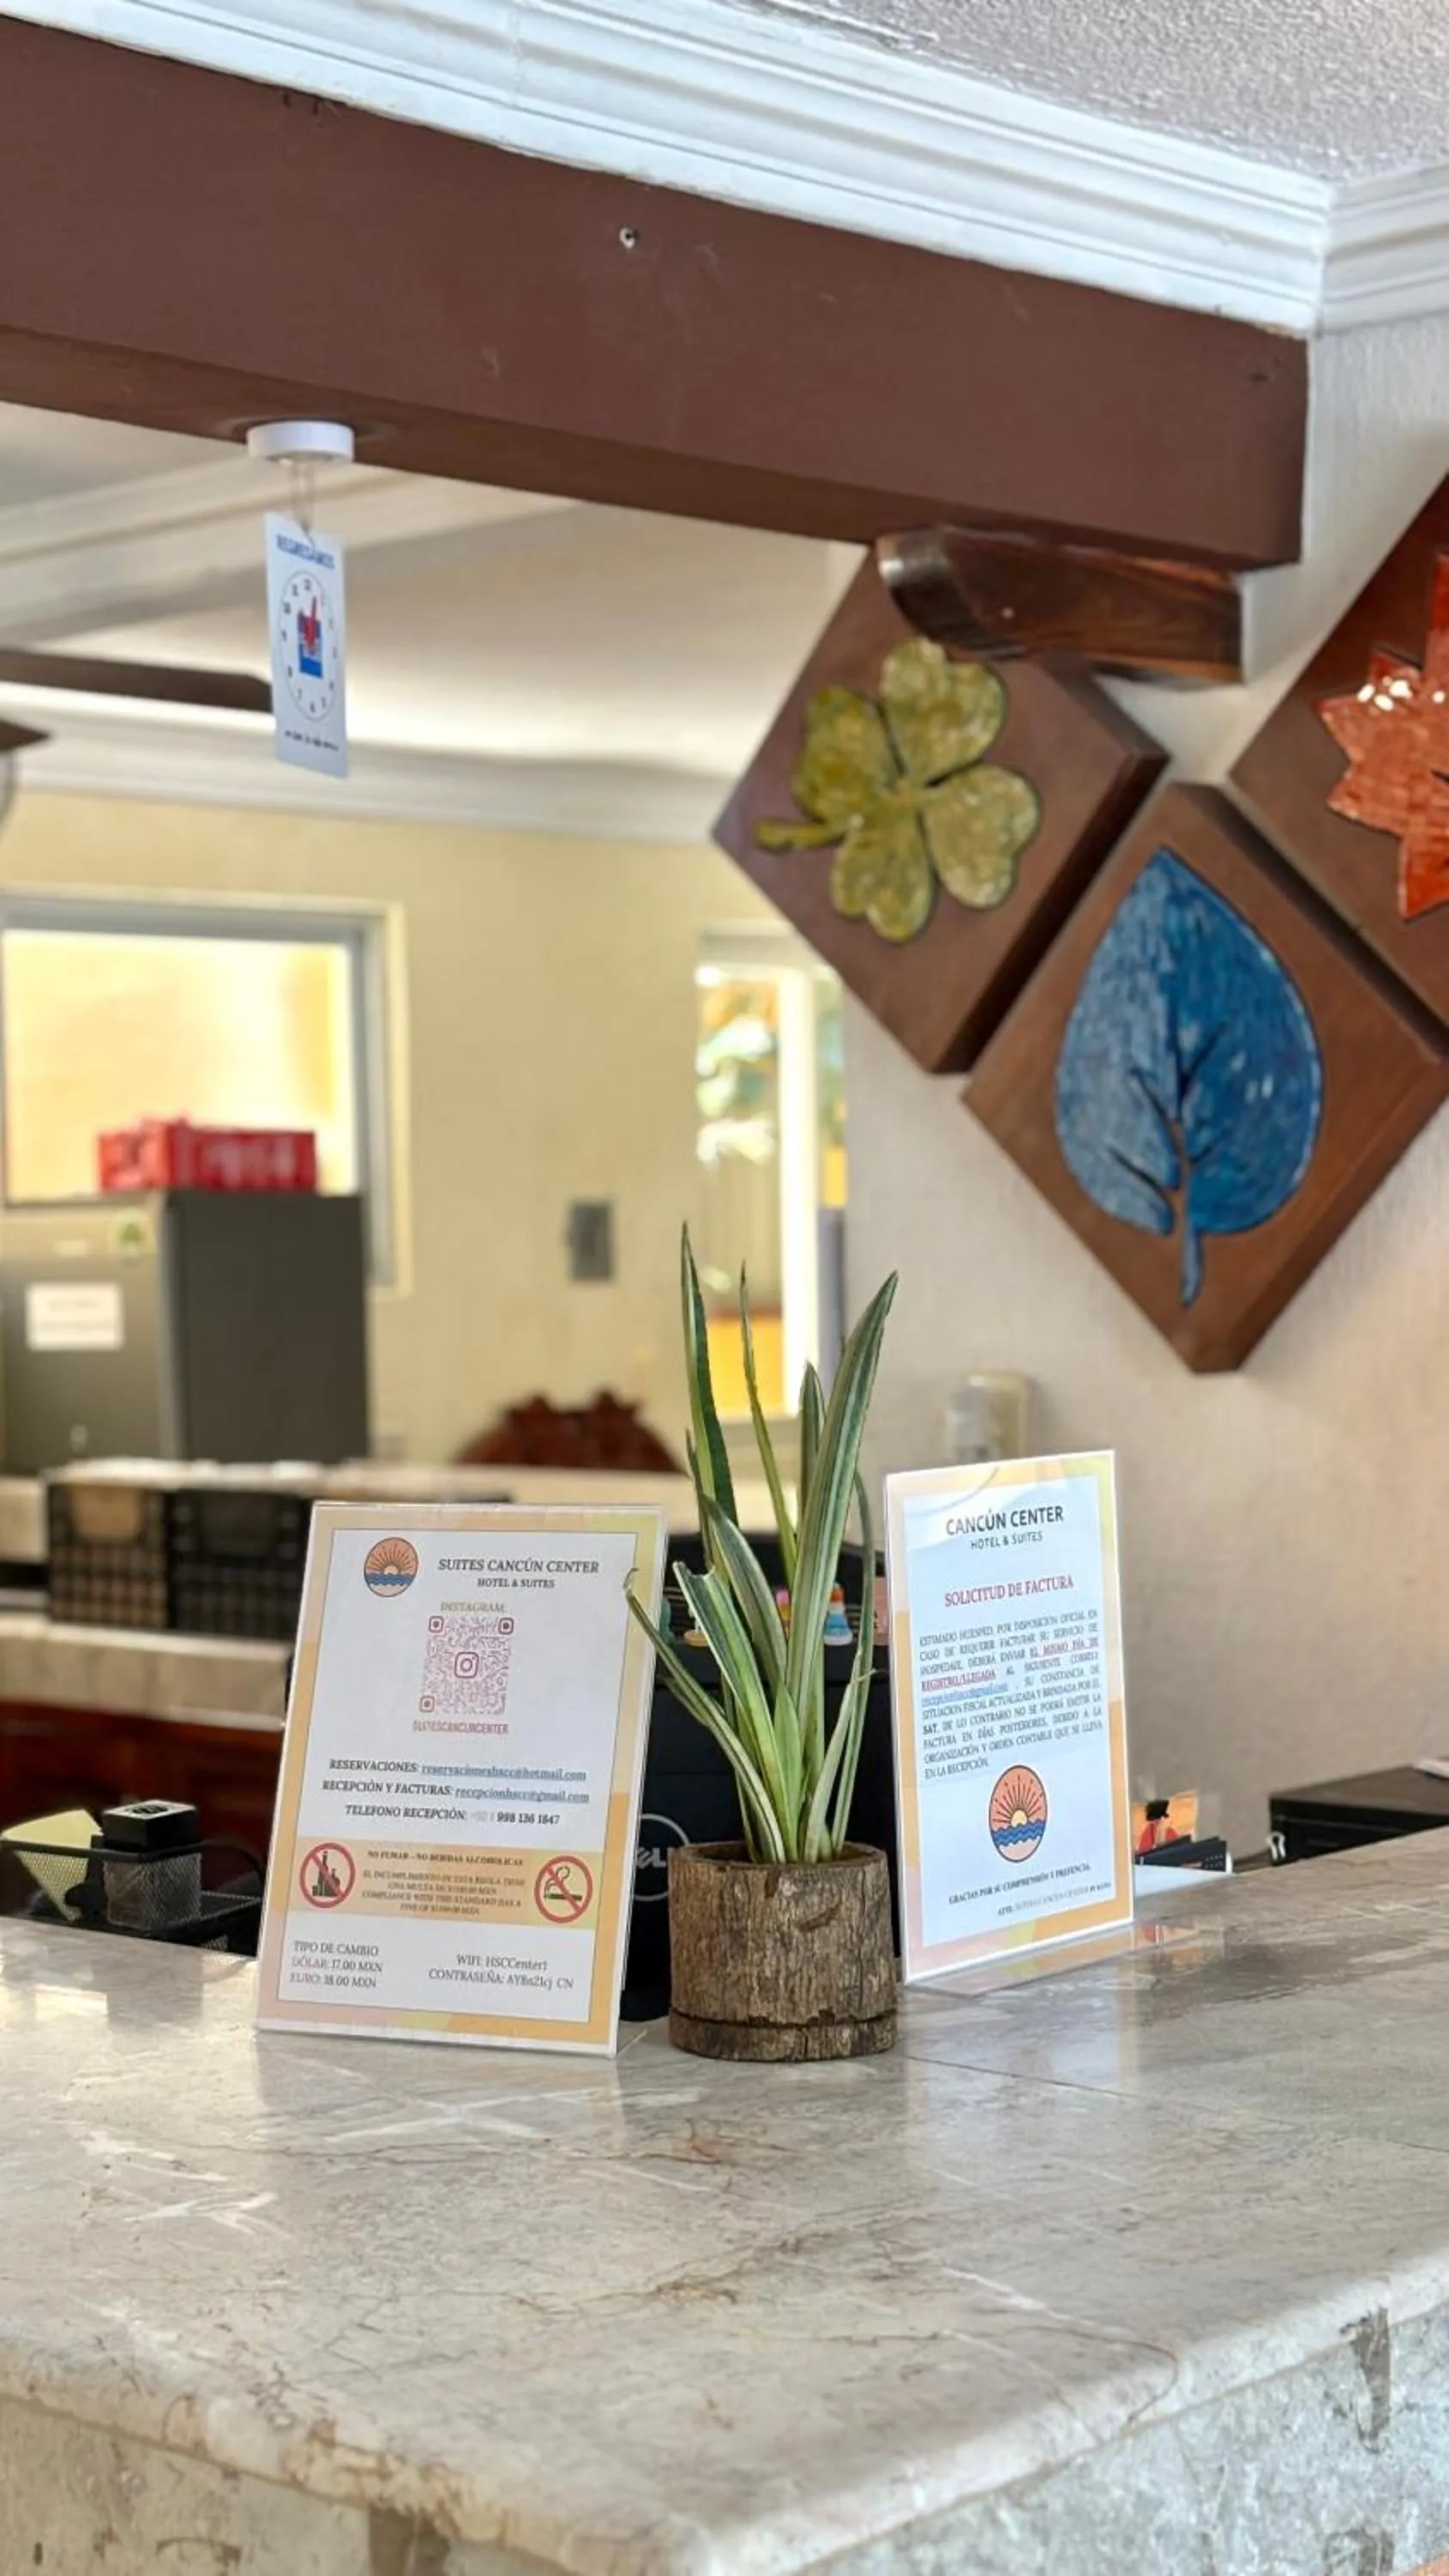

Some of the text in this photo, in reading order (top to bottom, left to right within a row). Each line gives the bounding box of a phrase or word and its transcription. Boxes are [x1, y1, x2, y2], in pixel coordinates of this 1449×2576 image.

[946, 1505, 1064, 1536] CANCÚN CENTER
[971, 1530, 1043, 1550] HOTEL & SUITES
[438, 1557, 599, 1573] SUITES CANCÚN CENTER
[477, 1578, 510, 1588] HOTEL
[521, 1579, 555, 1589] SUITES
[945, 1575, 1075, 1607] SOLICITUD DE FACTURA
[322, 1777, 384, 1793] RECEPCIÓN
[386, 1783, 394, 1793] Y
[345, 1804, 401, 1817] TELEFONO
[496, 1811, 516, 1822] 998
[294, 1941, 379, 1956] TIPO DE CAMBIO
[359, 1960, 383, 1972] MXN
[352, 1977, 377, 1989] MXN
